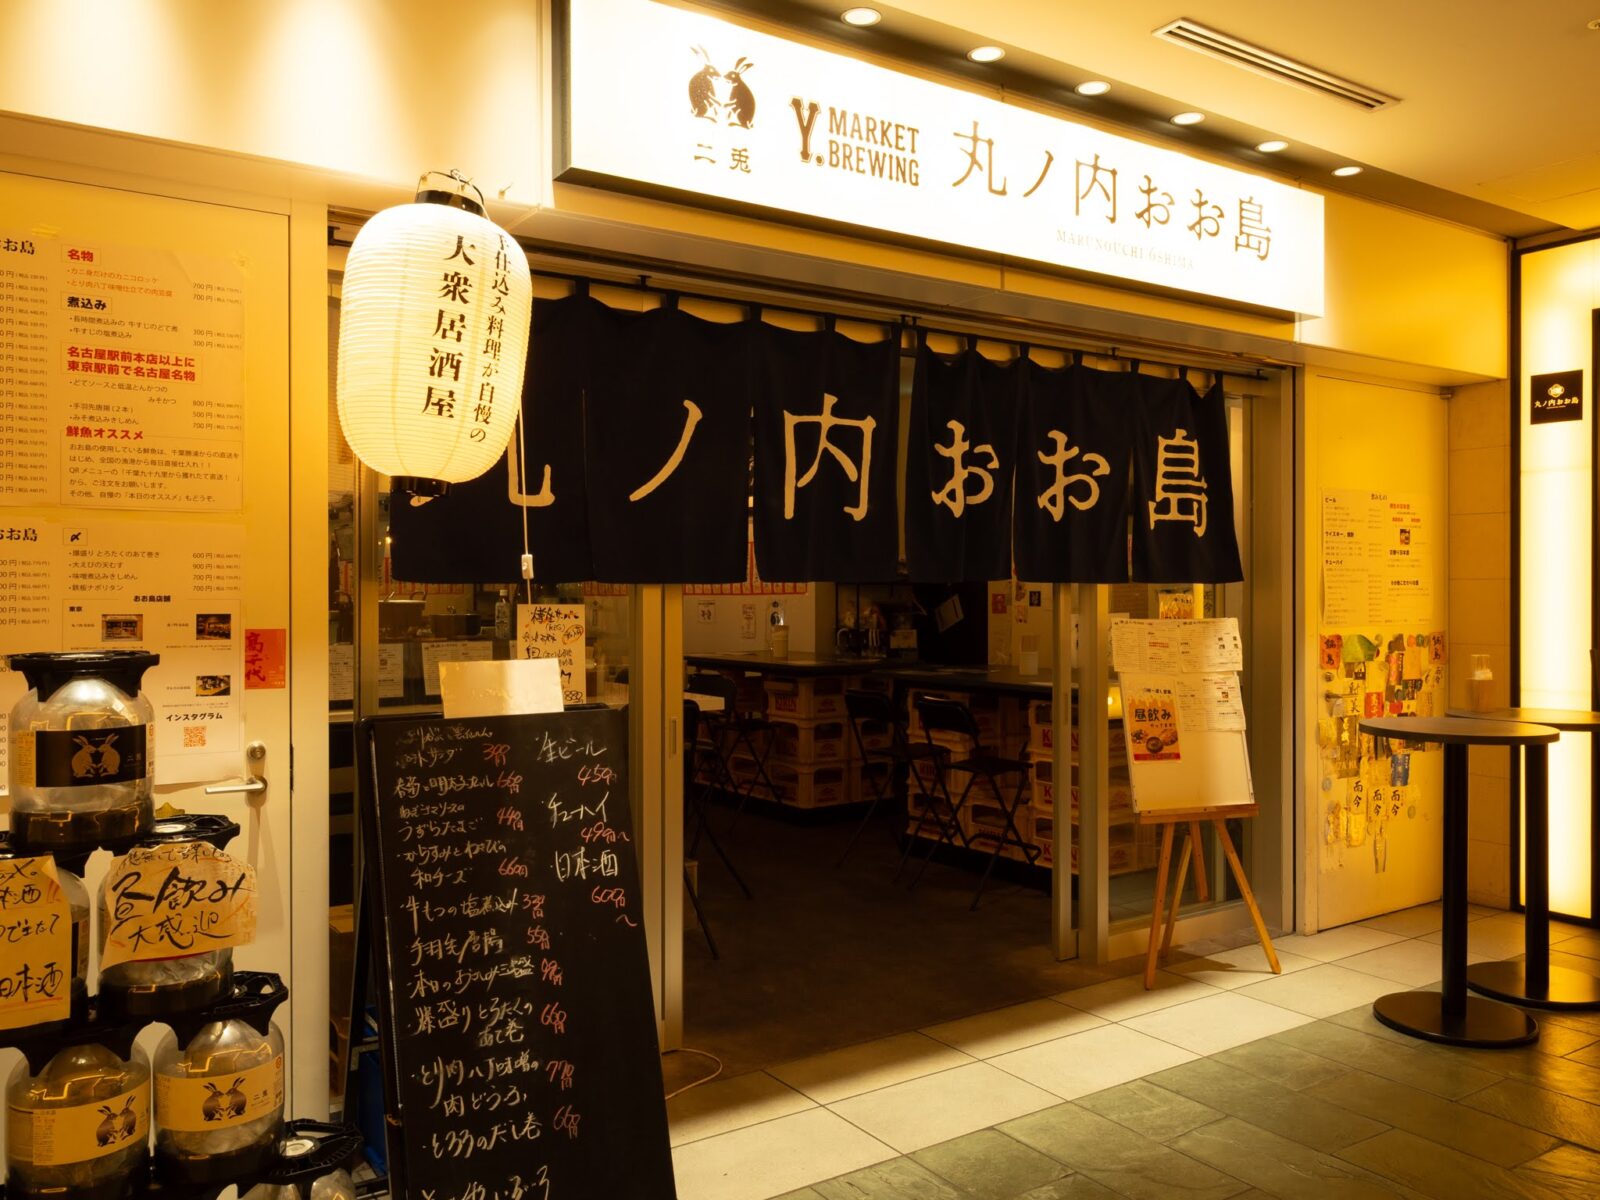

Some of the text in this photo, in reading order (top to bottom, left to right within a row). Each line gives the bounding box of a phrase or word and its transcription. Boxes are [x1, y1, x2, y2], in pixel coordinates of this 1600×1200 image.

[829, 106, 919, 154] MARKET
[829, 139, 919, 187] BREWING
[952, 120, 1272, 262] 丸ノ内おお島
[0, 238, 35, 256] お島
[67, 248, 94, 263] 名物
[1056, 228, 1144, 261] MARUNOUCHI
[67, 296, 107, 311] 煮込み
[422, 234, 477, 419] 大衆居酒屋
[67, 346, 196, 368] 名古屋駅前本店以上に
[67, 360, 196, 382] 東京駅前で名古屋名物
[66, 426, 144, 440] 鮮魚オススメ
[166, 711, 223, 722] インスタグラム
[1134, 706, 1172, 723] 昼飲み
[443, 1085, 528, 1117] 肉どうふ
